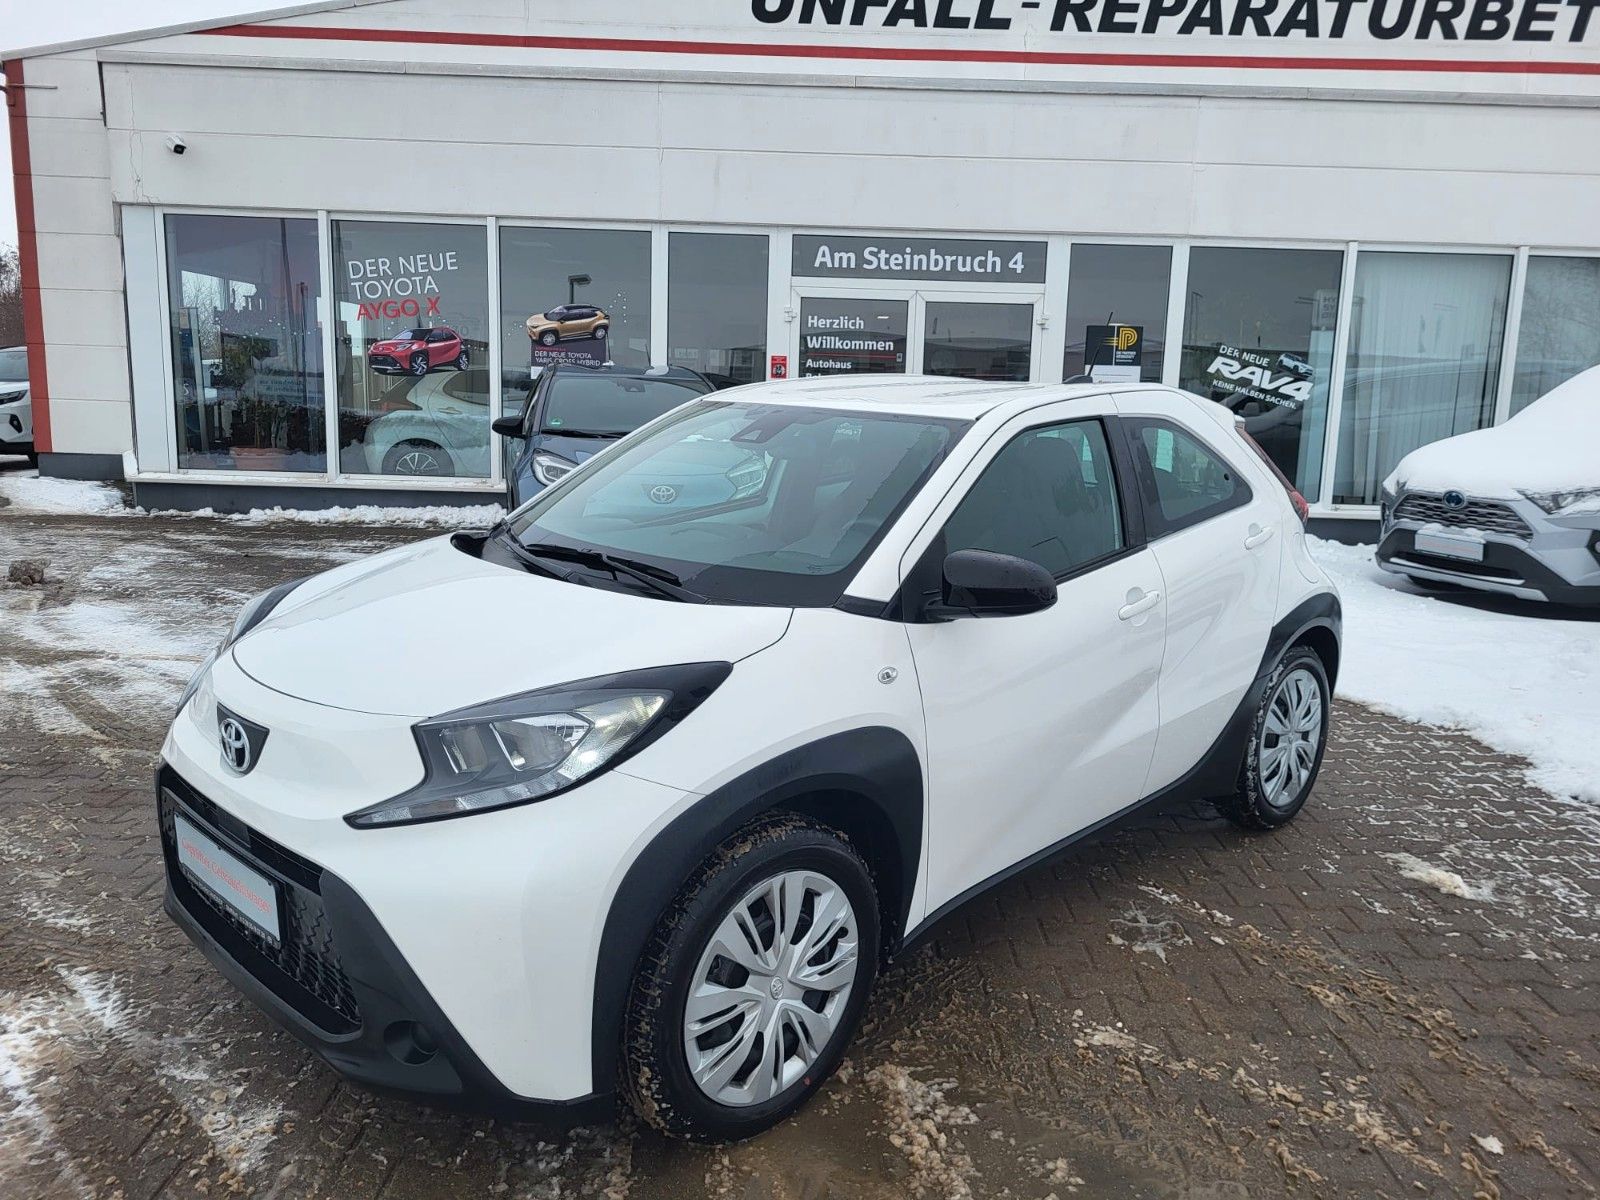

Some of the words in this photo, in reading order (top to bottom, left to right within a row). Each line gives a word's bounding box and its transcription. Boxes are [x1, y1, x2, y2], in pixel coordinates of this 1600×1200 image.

[348, 257, 393, 279] DER
[398, 251, 459, 275] NEUE
[814, 245, 856, 269] Am
[862, 246, 1001, 273] Steinbruch
[1008, 251, 1025, 274] 4
[351, 275, 439, 300] TOYOTA
[357, 297, 420, 321] AYGO
[426, 296, 441, 315] X
[807, 315, 864, 330] Herzlich
[806, 335, 894, 351] Willkommen
[1219, 344, 1240, 358] DER
[1241, 351, 1270, 367] NEUE
[805, 358, 852, 369] Autohaus
[1206, 356, 1314, 402] RAV4
[1212, 379, 1235, 391] KEINE
[1235, 385, 1265, 400] HALBEN
[1264, 394, 1297, 410] SACHEN.
